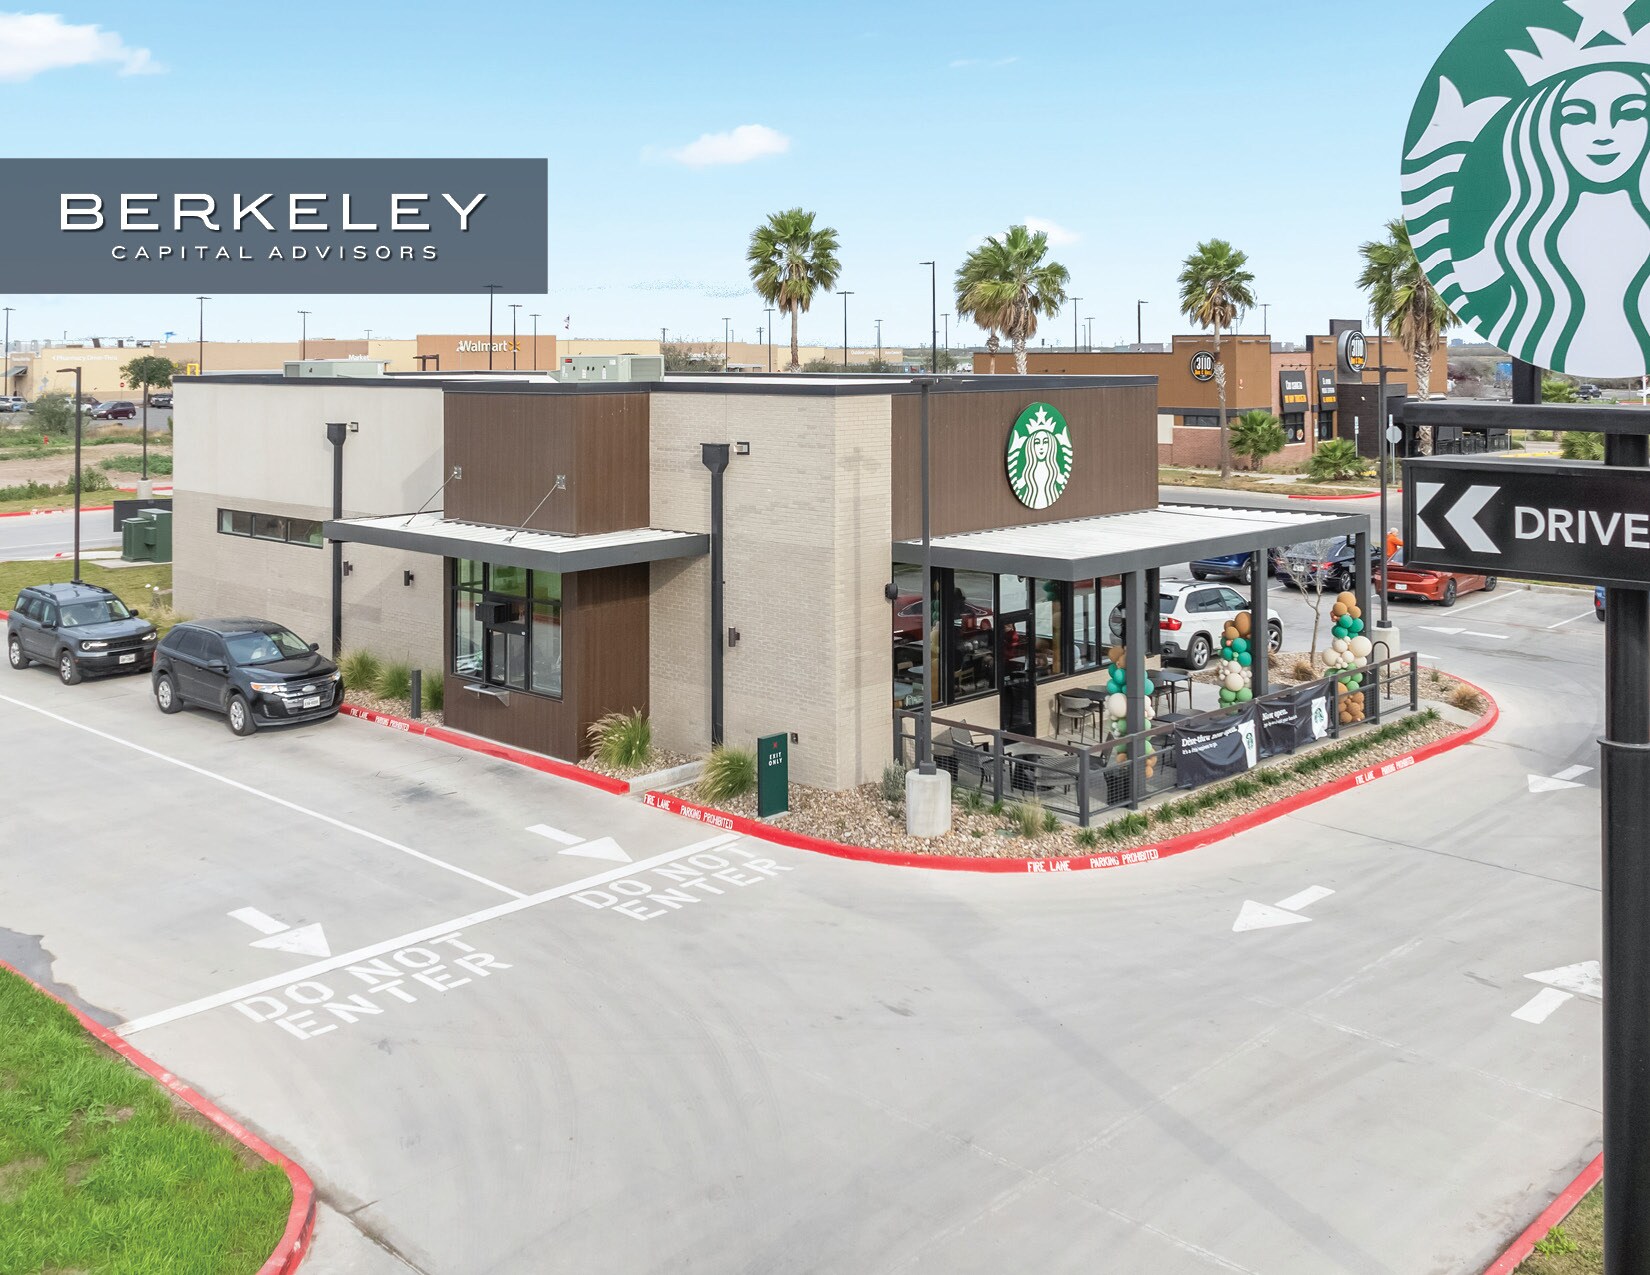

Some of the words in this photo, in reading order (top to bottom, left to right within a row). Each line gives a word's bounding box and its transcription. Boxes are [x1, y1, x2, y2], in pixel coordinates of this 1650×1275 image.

[460, 340, 508, 352] Walmart
[1514, 506, 1650, 549] DRIVE
[768, 757, 783, 766] ONLY
[769, 751, 782, 760] EXIT
[643, 794, 655, 806] FIRE
[656, 797, 671, 811] LANE
[679, 805, 701, 820] PARKING
[702, 812, 733, 830] PROHIBITED
[569, 879, 652, 909] DO
[651, 842, 756, 882] NOT
[1027, 861, 1046, 872] FIRE
[1049, 860, 1072, 872] LANE
[1090, 856, 1120, 869] PARKING
[1121, 849, 1159, 864] PROHIBITED
[612, 858, 795, 921] ENTER
[230, 981, 335, 1023] DO
[344, 931, 477, 985] NOT
[274, 952, 514, 1041] ENTER
